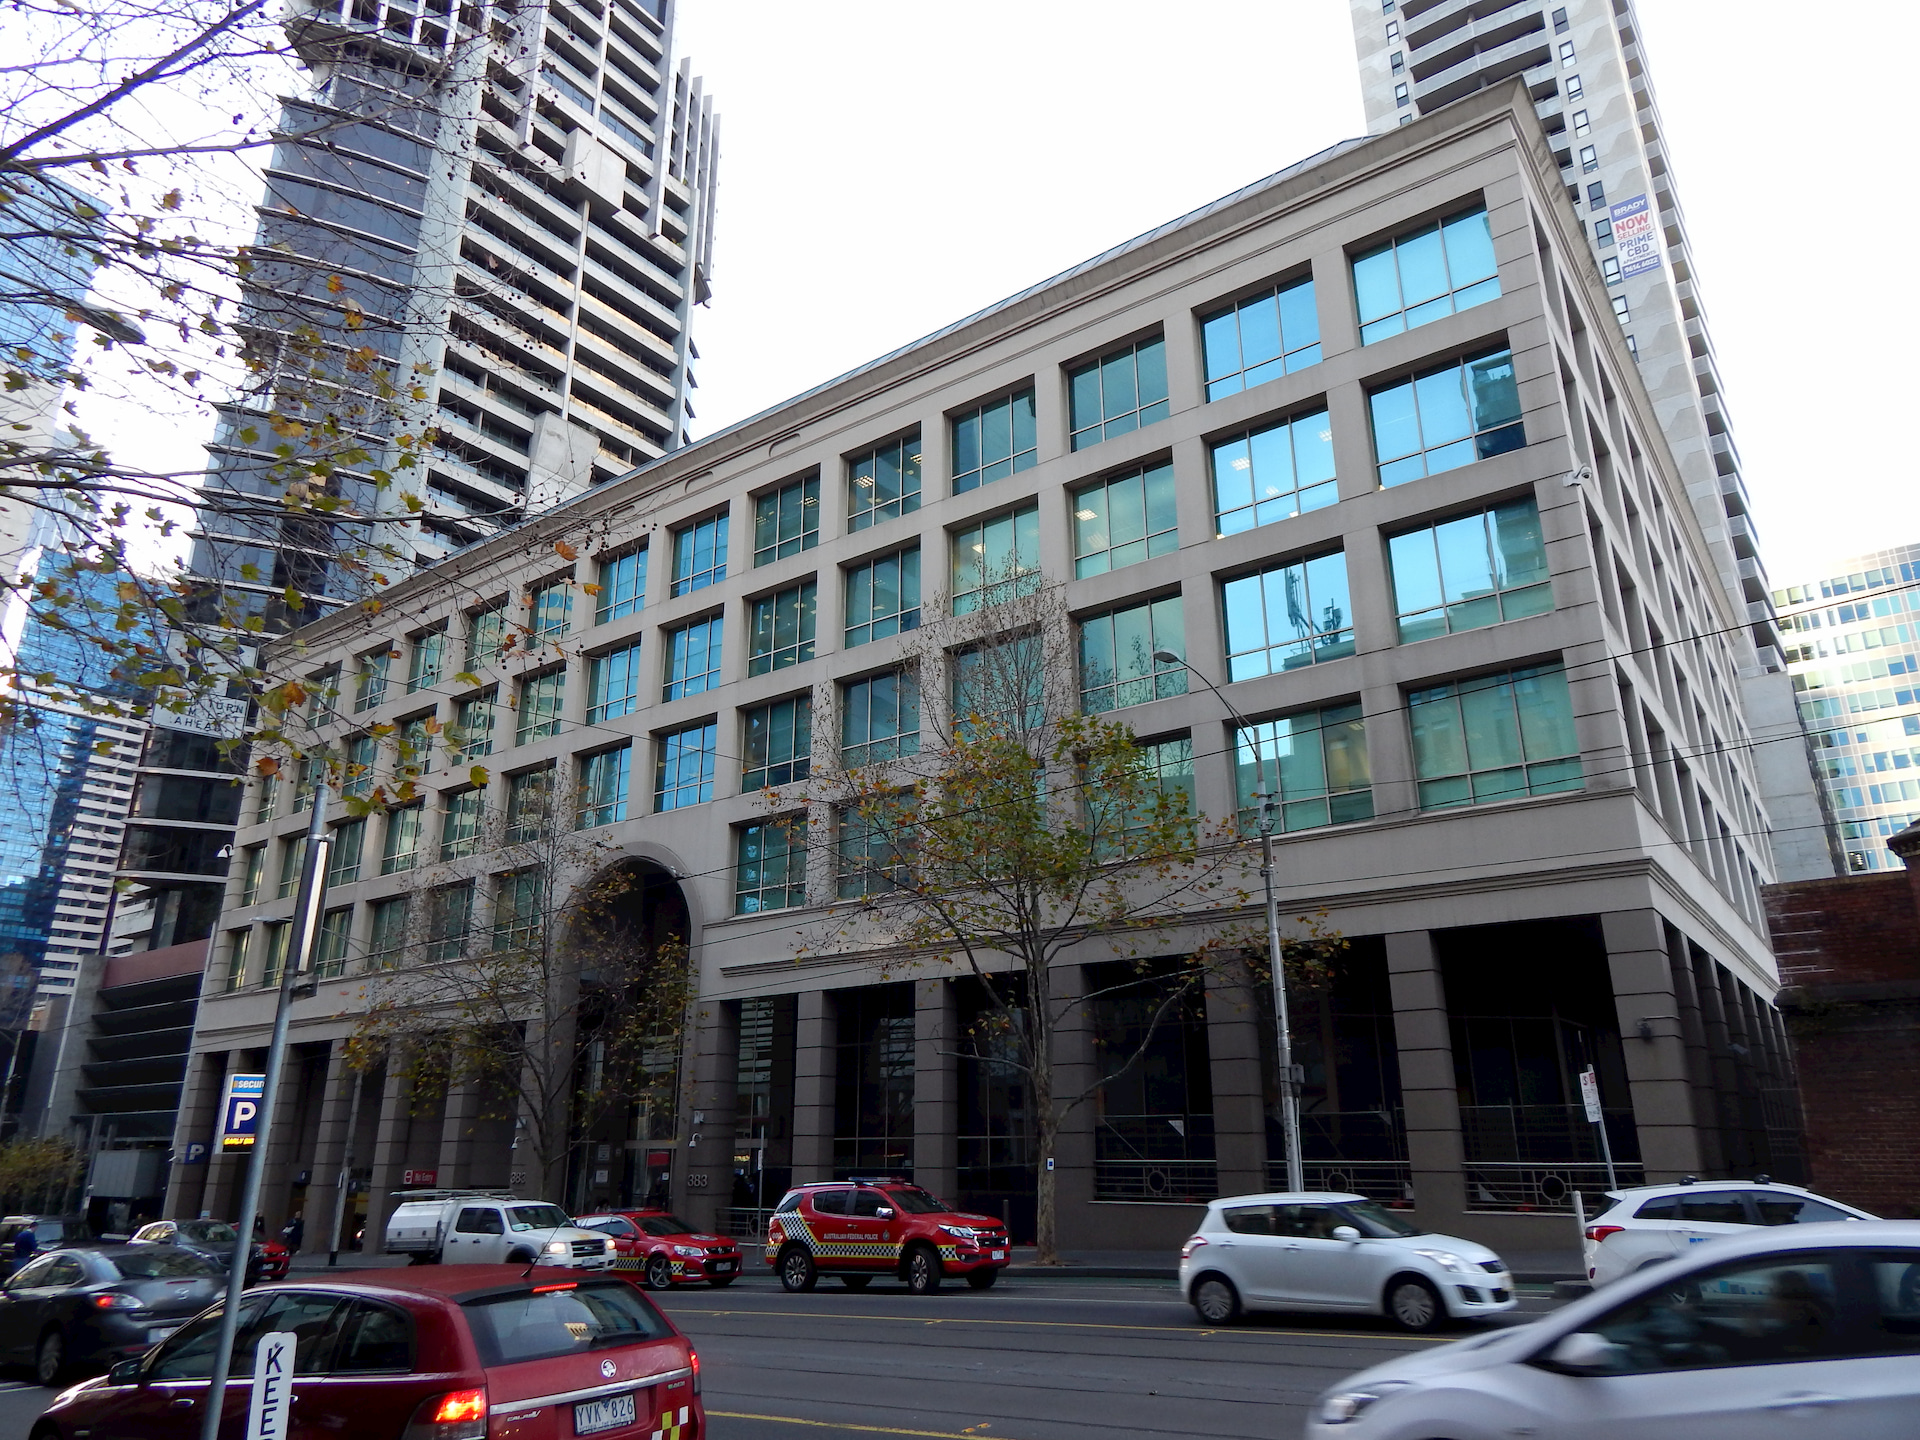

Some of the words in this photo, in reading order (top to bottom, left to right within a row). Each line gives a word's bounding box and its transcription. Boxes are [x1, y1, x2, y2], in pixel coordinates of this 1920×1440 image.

[1613, 198, 1646, 216] BRADY
[1615, 212, 1649, 233] NOW
[1617, 223, 1651, 240] SELLING
[1619, 231, 1654, 251] PRIME
[1627, 243, 1650, 257] CBD
[238, 1080, 265, 1089] secur
[233, 1101, 257, 1130] P
[188, 1144, 205, 1160] P
[687, 1174, 708, 1187] 383
[259, 1346, 285, 1440] KEE
[577, 1403, 600, 1426] YVK
[611, 1397, 634, 1418] 826
